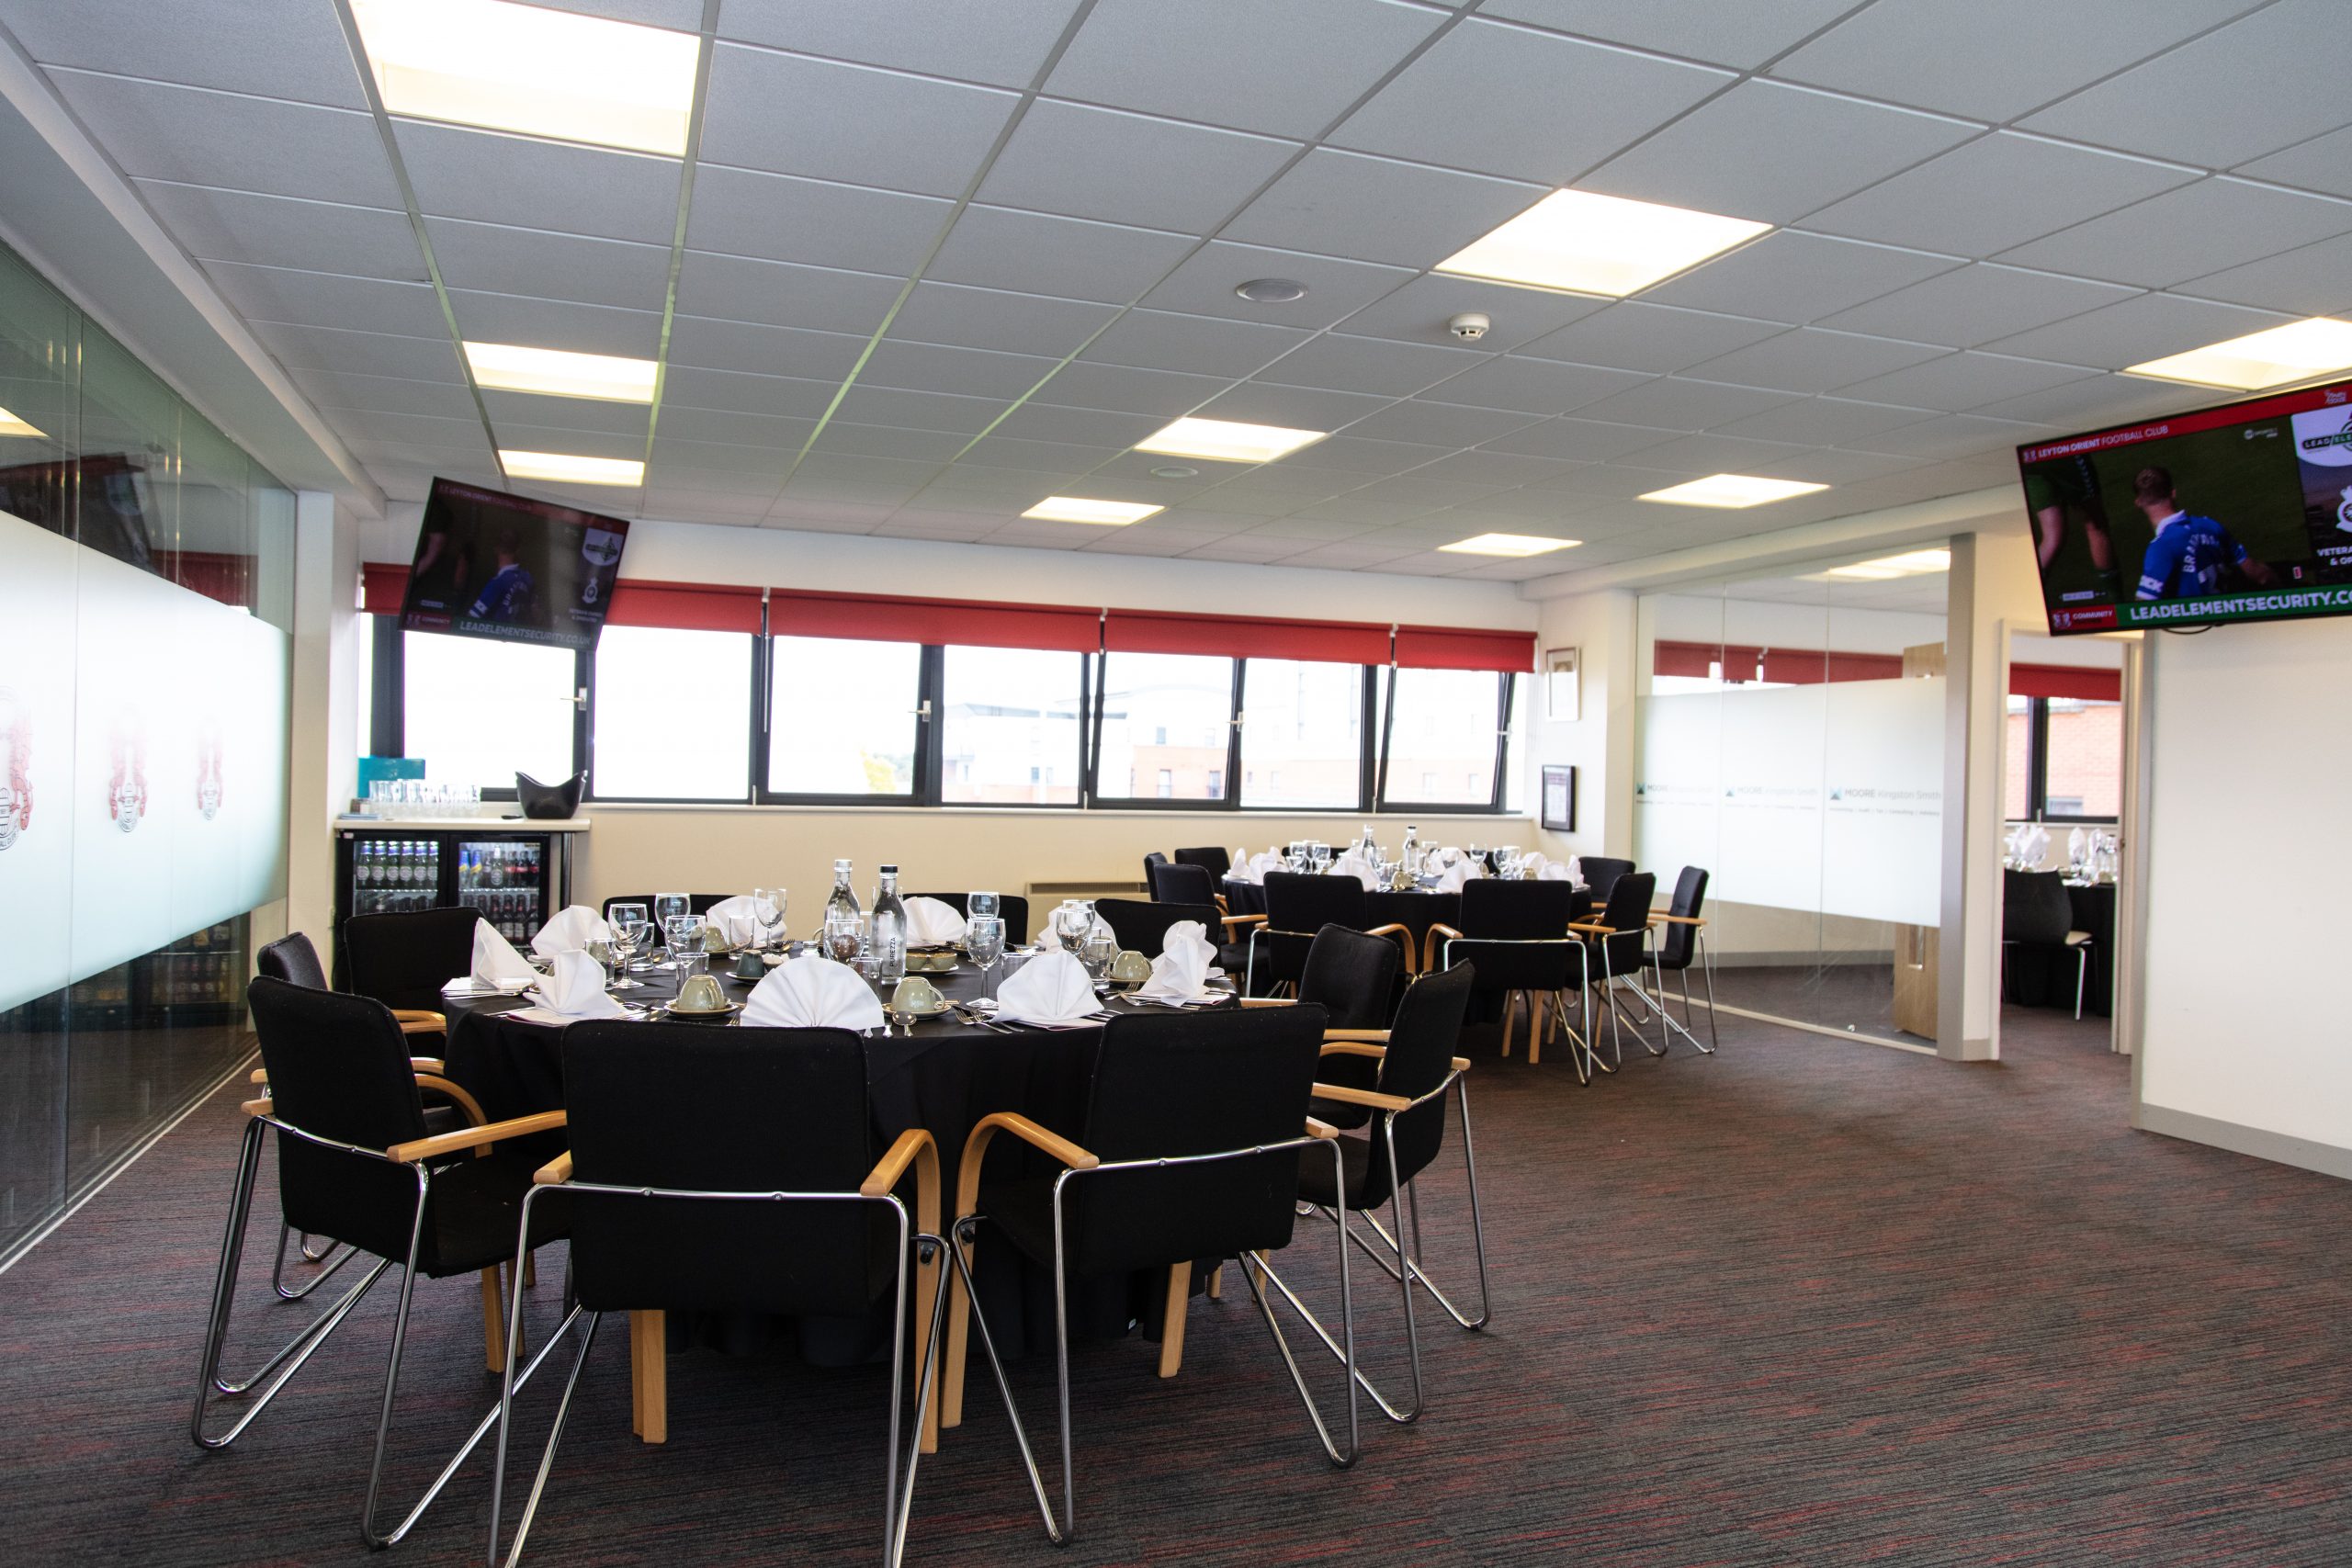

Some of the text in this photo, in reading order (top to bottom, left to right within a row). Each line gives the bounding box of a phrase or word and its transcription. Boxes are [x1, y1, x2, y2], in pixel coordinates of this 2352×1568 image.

[2039, 425, 2168, 458] LEYTON ORIENT FOOTBALL CLUB
[2304, 437, 2331, 448] LEAD
[2073, 610, 2113, 621] COMMUNITY
[1845, 788, 1941, 801] MOORE Kingston Smith
